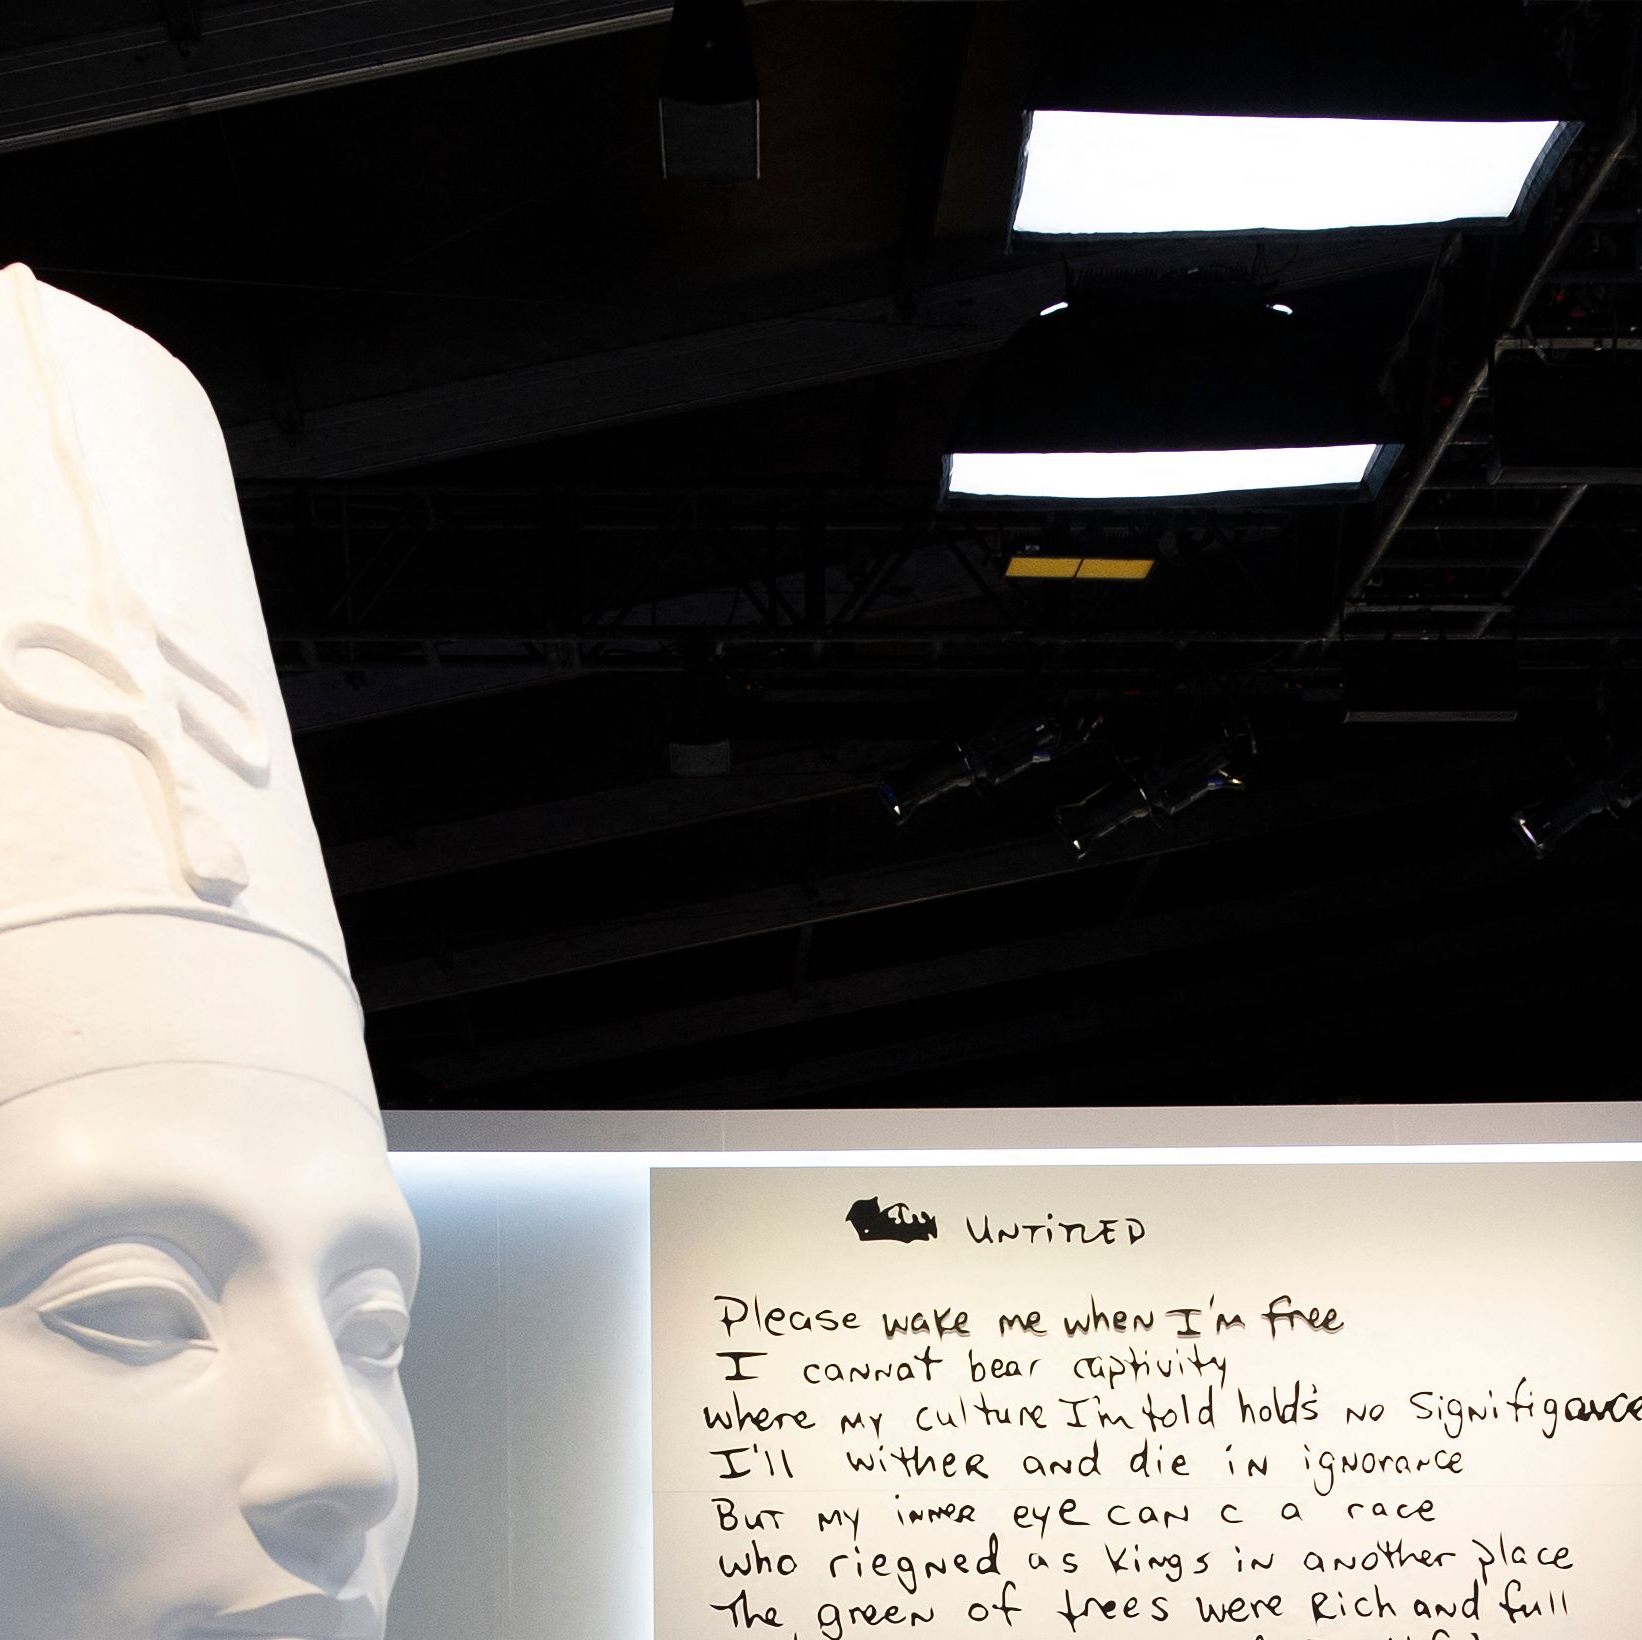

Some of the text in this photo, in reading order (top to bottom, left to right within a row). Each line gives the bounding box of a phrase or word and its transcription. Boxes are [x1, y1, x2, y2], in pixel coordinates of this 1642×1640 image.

[713, 1294, 1345, 1339] Please wake me when I'm free
[715, 1351, 768, 1381] I
[968, 1349, 1039, 1383] bear
[703, 1390, 816, 1432] where
[840, 1412, 883, 1437] my
[916, 1393, 1047, 1432] culture
[1058, 1395, 1133, 1430] I'm
[1346, 1404, 1385, 1424] no
[709, 1439, 1463, 1497] I'll wither and die in ignorance
[817, 1509, 859, 1541] my
[1013, 1498, 1090, 1538] eye
[1107, 1505, 1189, 1529] can
[1281, 1502, 1303, 1521] a
[1347, 1499, 1436, 1522] race
[718, 1539, 798, 1578] who
[1028, 1552, 1078, 1574] as
[1234, 1546, 1274, 1573] in
[1303, 1540, 1456, 1573] another
[967, 1580, 1022, 1627] of
[1057, 1589, 1169, 1633] trees
[1195, 1595, 1283, 1623] were
[1413, 1578, 1480, 1621] and
[1499, 1578, 1568, 1624] full
